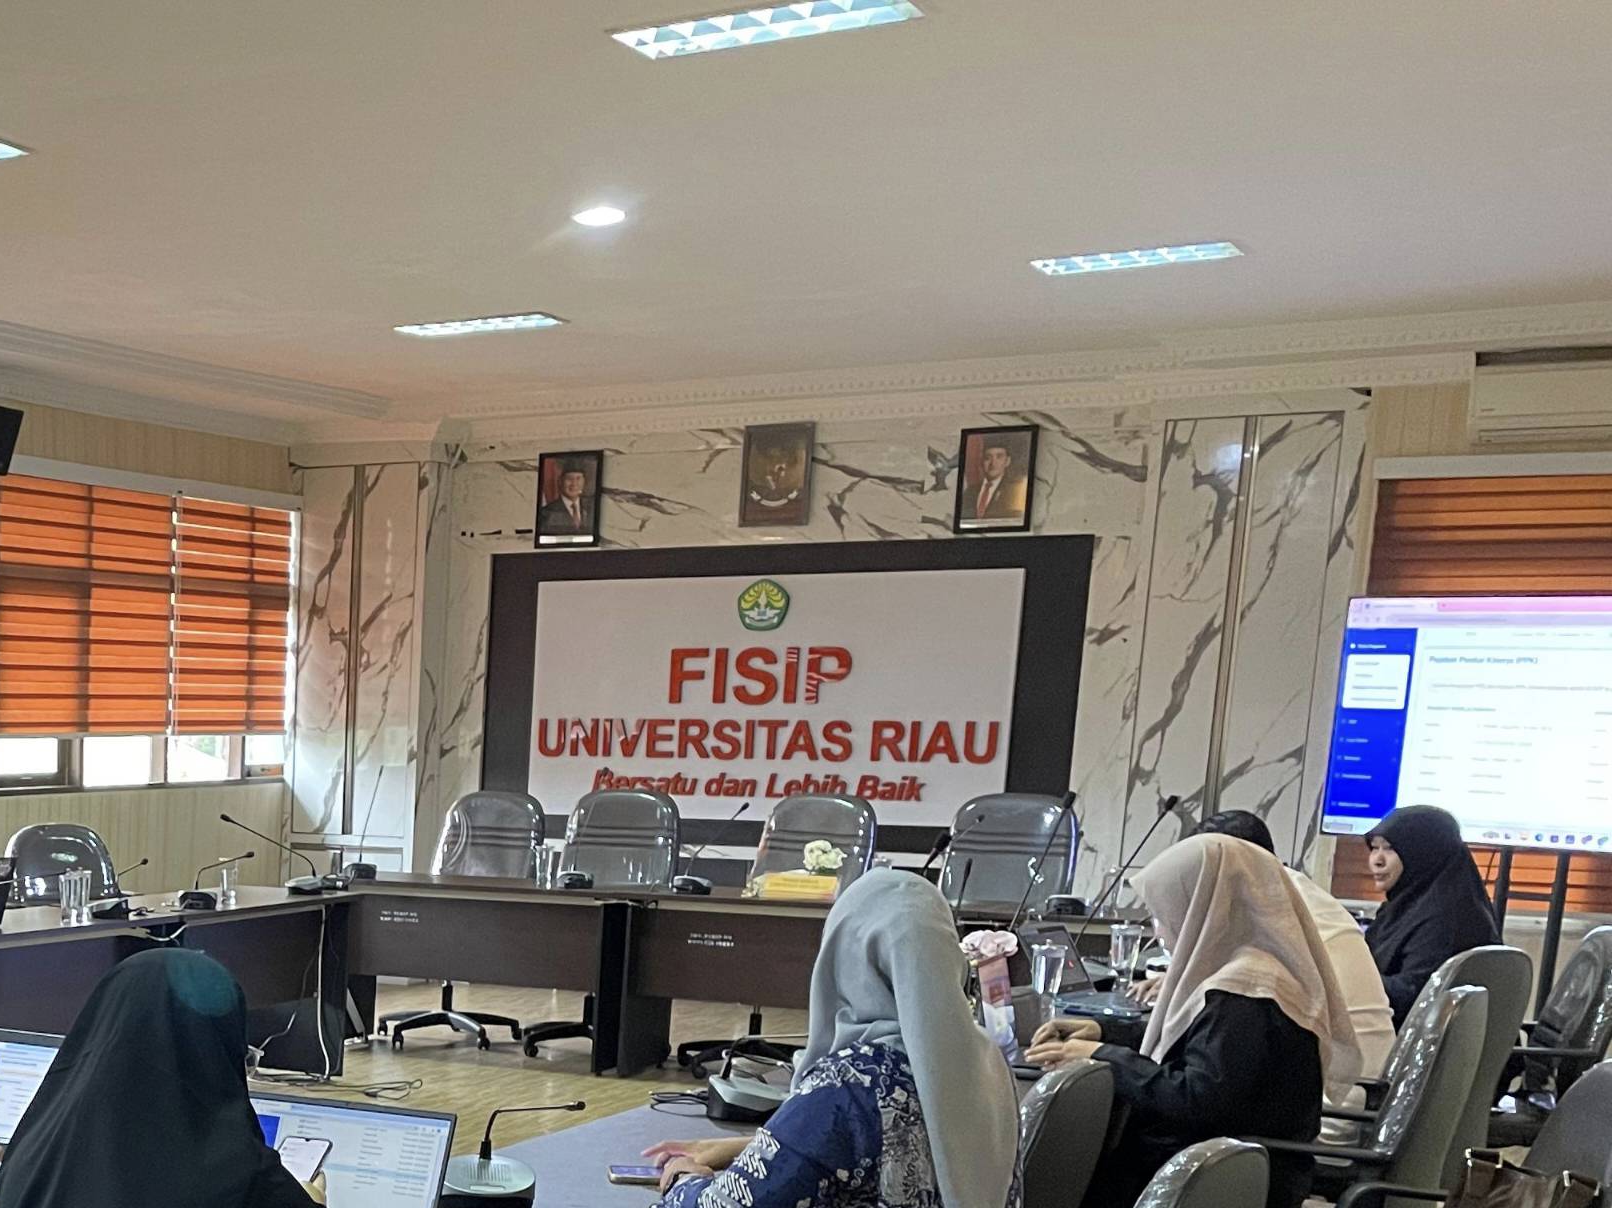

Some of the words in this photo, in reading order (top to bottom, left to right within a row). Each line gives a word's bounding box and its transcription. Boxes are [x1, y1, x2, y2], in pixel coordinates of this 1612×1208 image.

[668, 646, 853, 706] FISIP
[538, 717, 853, 762] UNIVERSITAS
[869, 720, 1001, 765] RIAU
[591, 768, 699, 796] Bersatu
[704, 772, 756, 797] dan
[764, 773, 848, 798] Lebih
[855, 774, 927, 801] Baik
